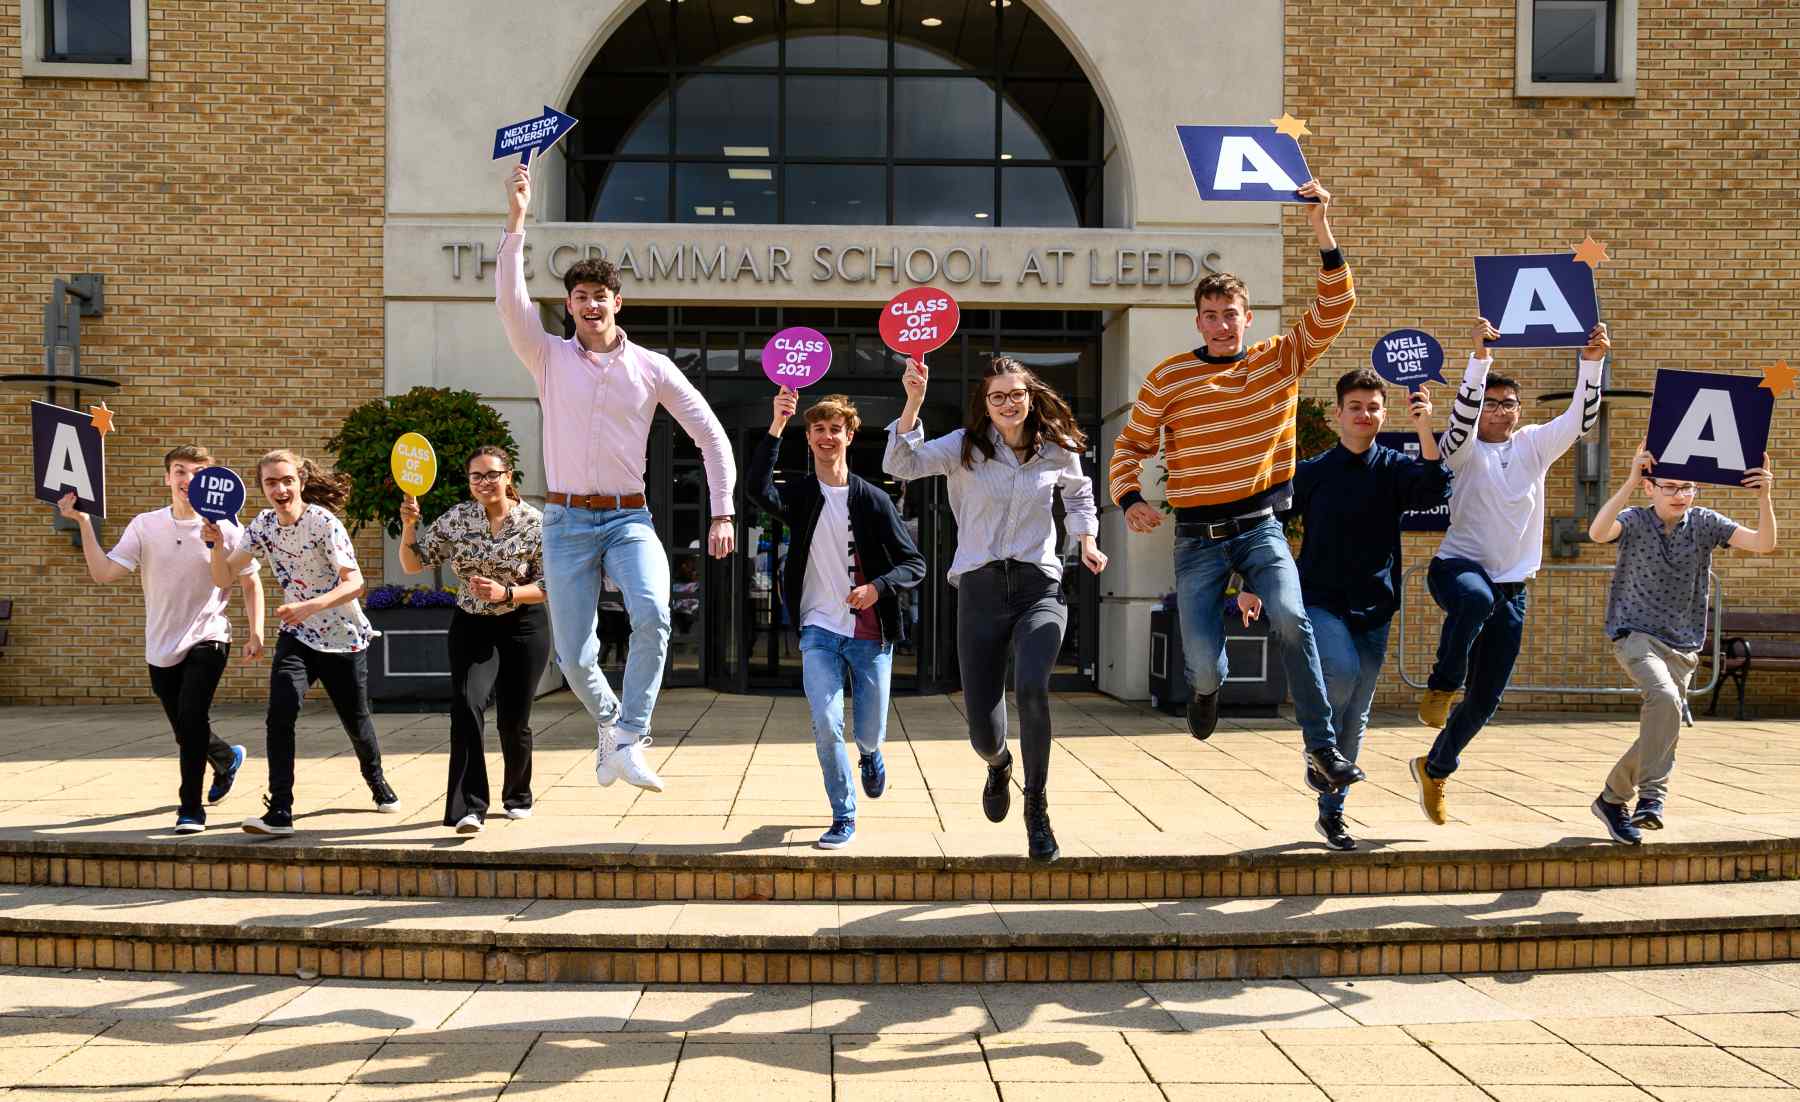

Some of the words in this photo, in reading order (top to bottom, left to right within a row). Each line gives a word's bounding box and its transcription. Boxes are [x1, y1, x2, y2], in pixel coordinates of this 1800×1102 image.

[503, 123, 531, 140] NEXT
[531, 115, 558, 131] STOP
[500, 124, 560, 149] UNIVERSITY
[1212, 135, 1301, 191] A
[810, 245, 1001, 285] SCHOOL
[1016, 247, 1075, 286] AT
[1088, 248, 1222, 286] LEEDS
[890, 298, 949, 316] CLASS
[1499, 267, 1585, 334] A
[906, 313, 932, 327] OF
[898, 326, 938, 342] 2021
[774, 337, 824, 353] CLASS
[1383, 335, 1427, 351] WELL
[785, 351, 808, 363] OF
[1386, 347, 1430, 363] DONE
[776, 363, 812, 377] 2021
[1397, 359, 1422, 373] US!
[1658, 387, 1747, 471] A
[397, 443, 430, 462] CLASS
[43, 422, 95, 502] A
[406, 458, 421, 471] OF
[200, 475, 206, 489] I
[208, 476, 235, 492] DID
[206, 491, 225, 506] IT!
